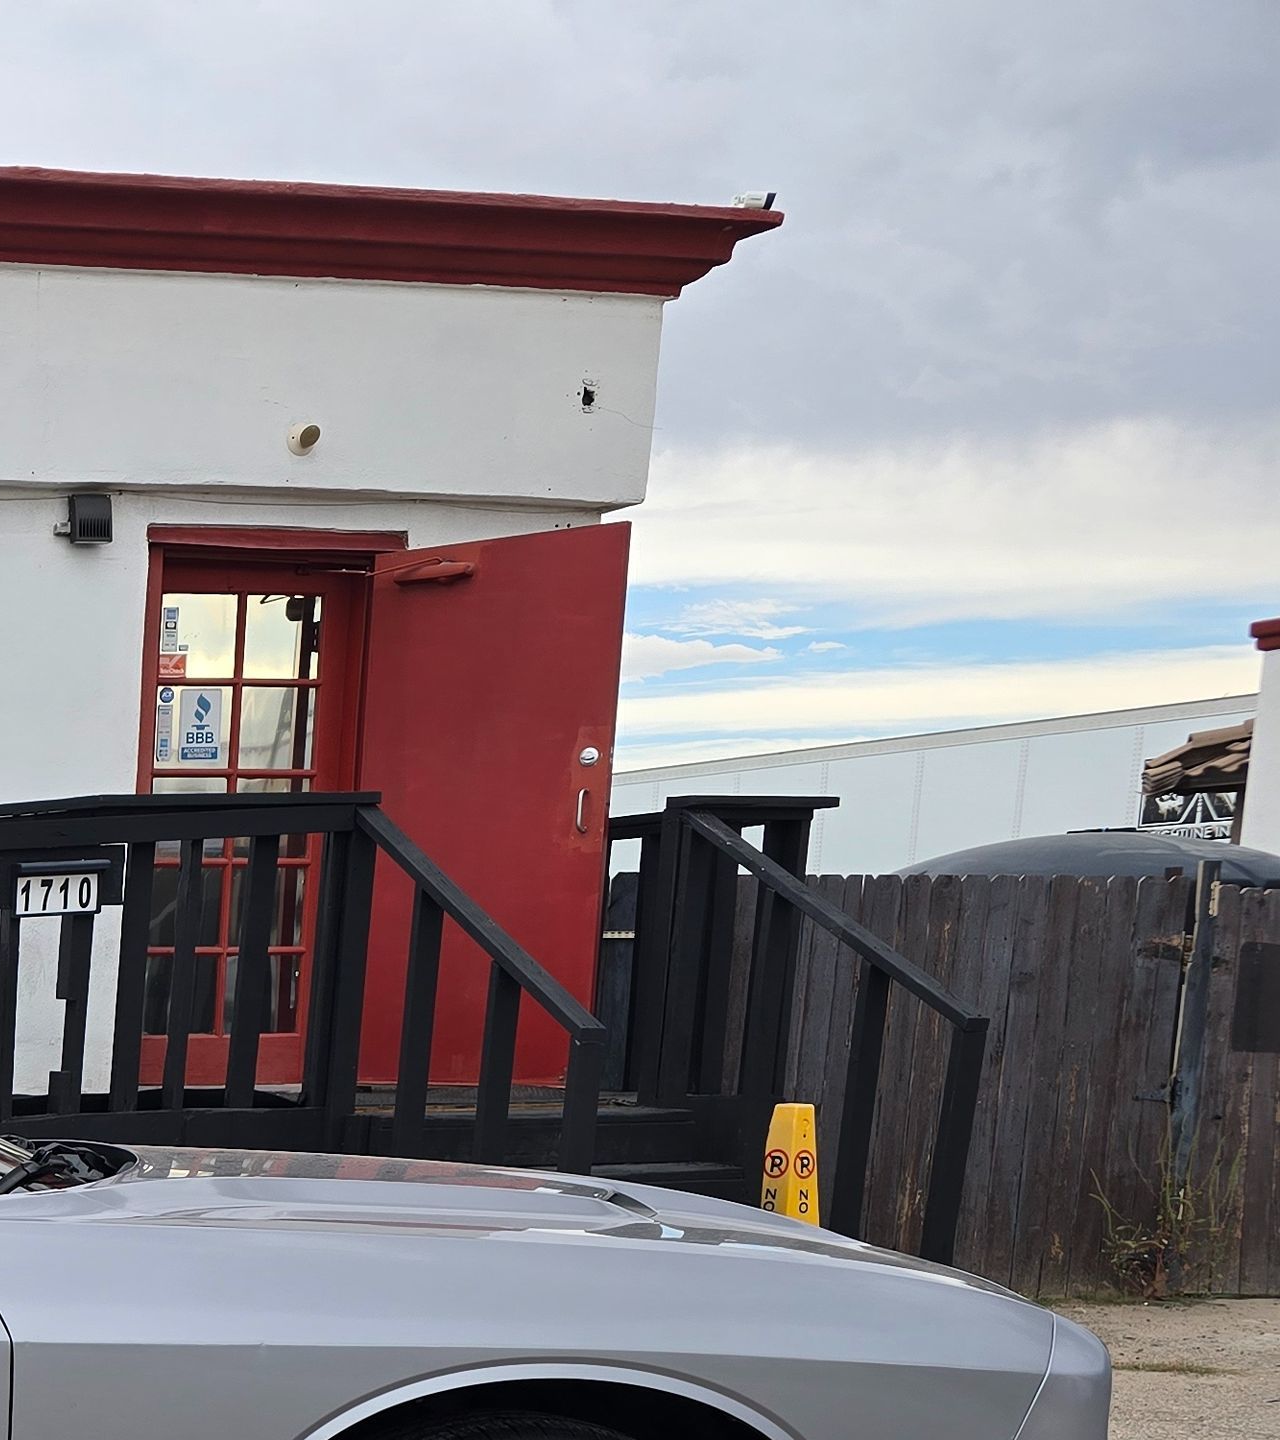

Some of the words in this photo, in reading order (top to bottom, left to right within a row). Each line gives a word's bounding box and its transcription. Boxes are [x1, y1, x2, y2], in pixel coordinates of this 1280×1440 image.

[186, 732, 214, 744] BBB
[21, 877, 91, 911] 1710
[800, 1189, 808, 1213] NO
